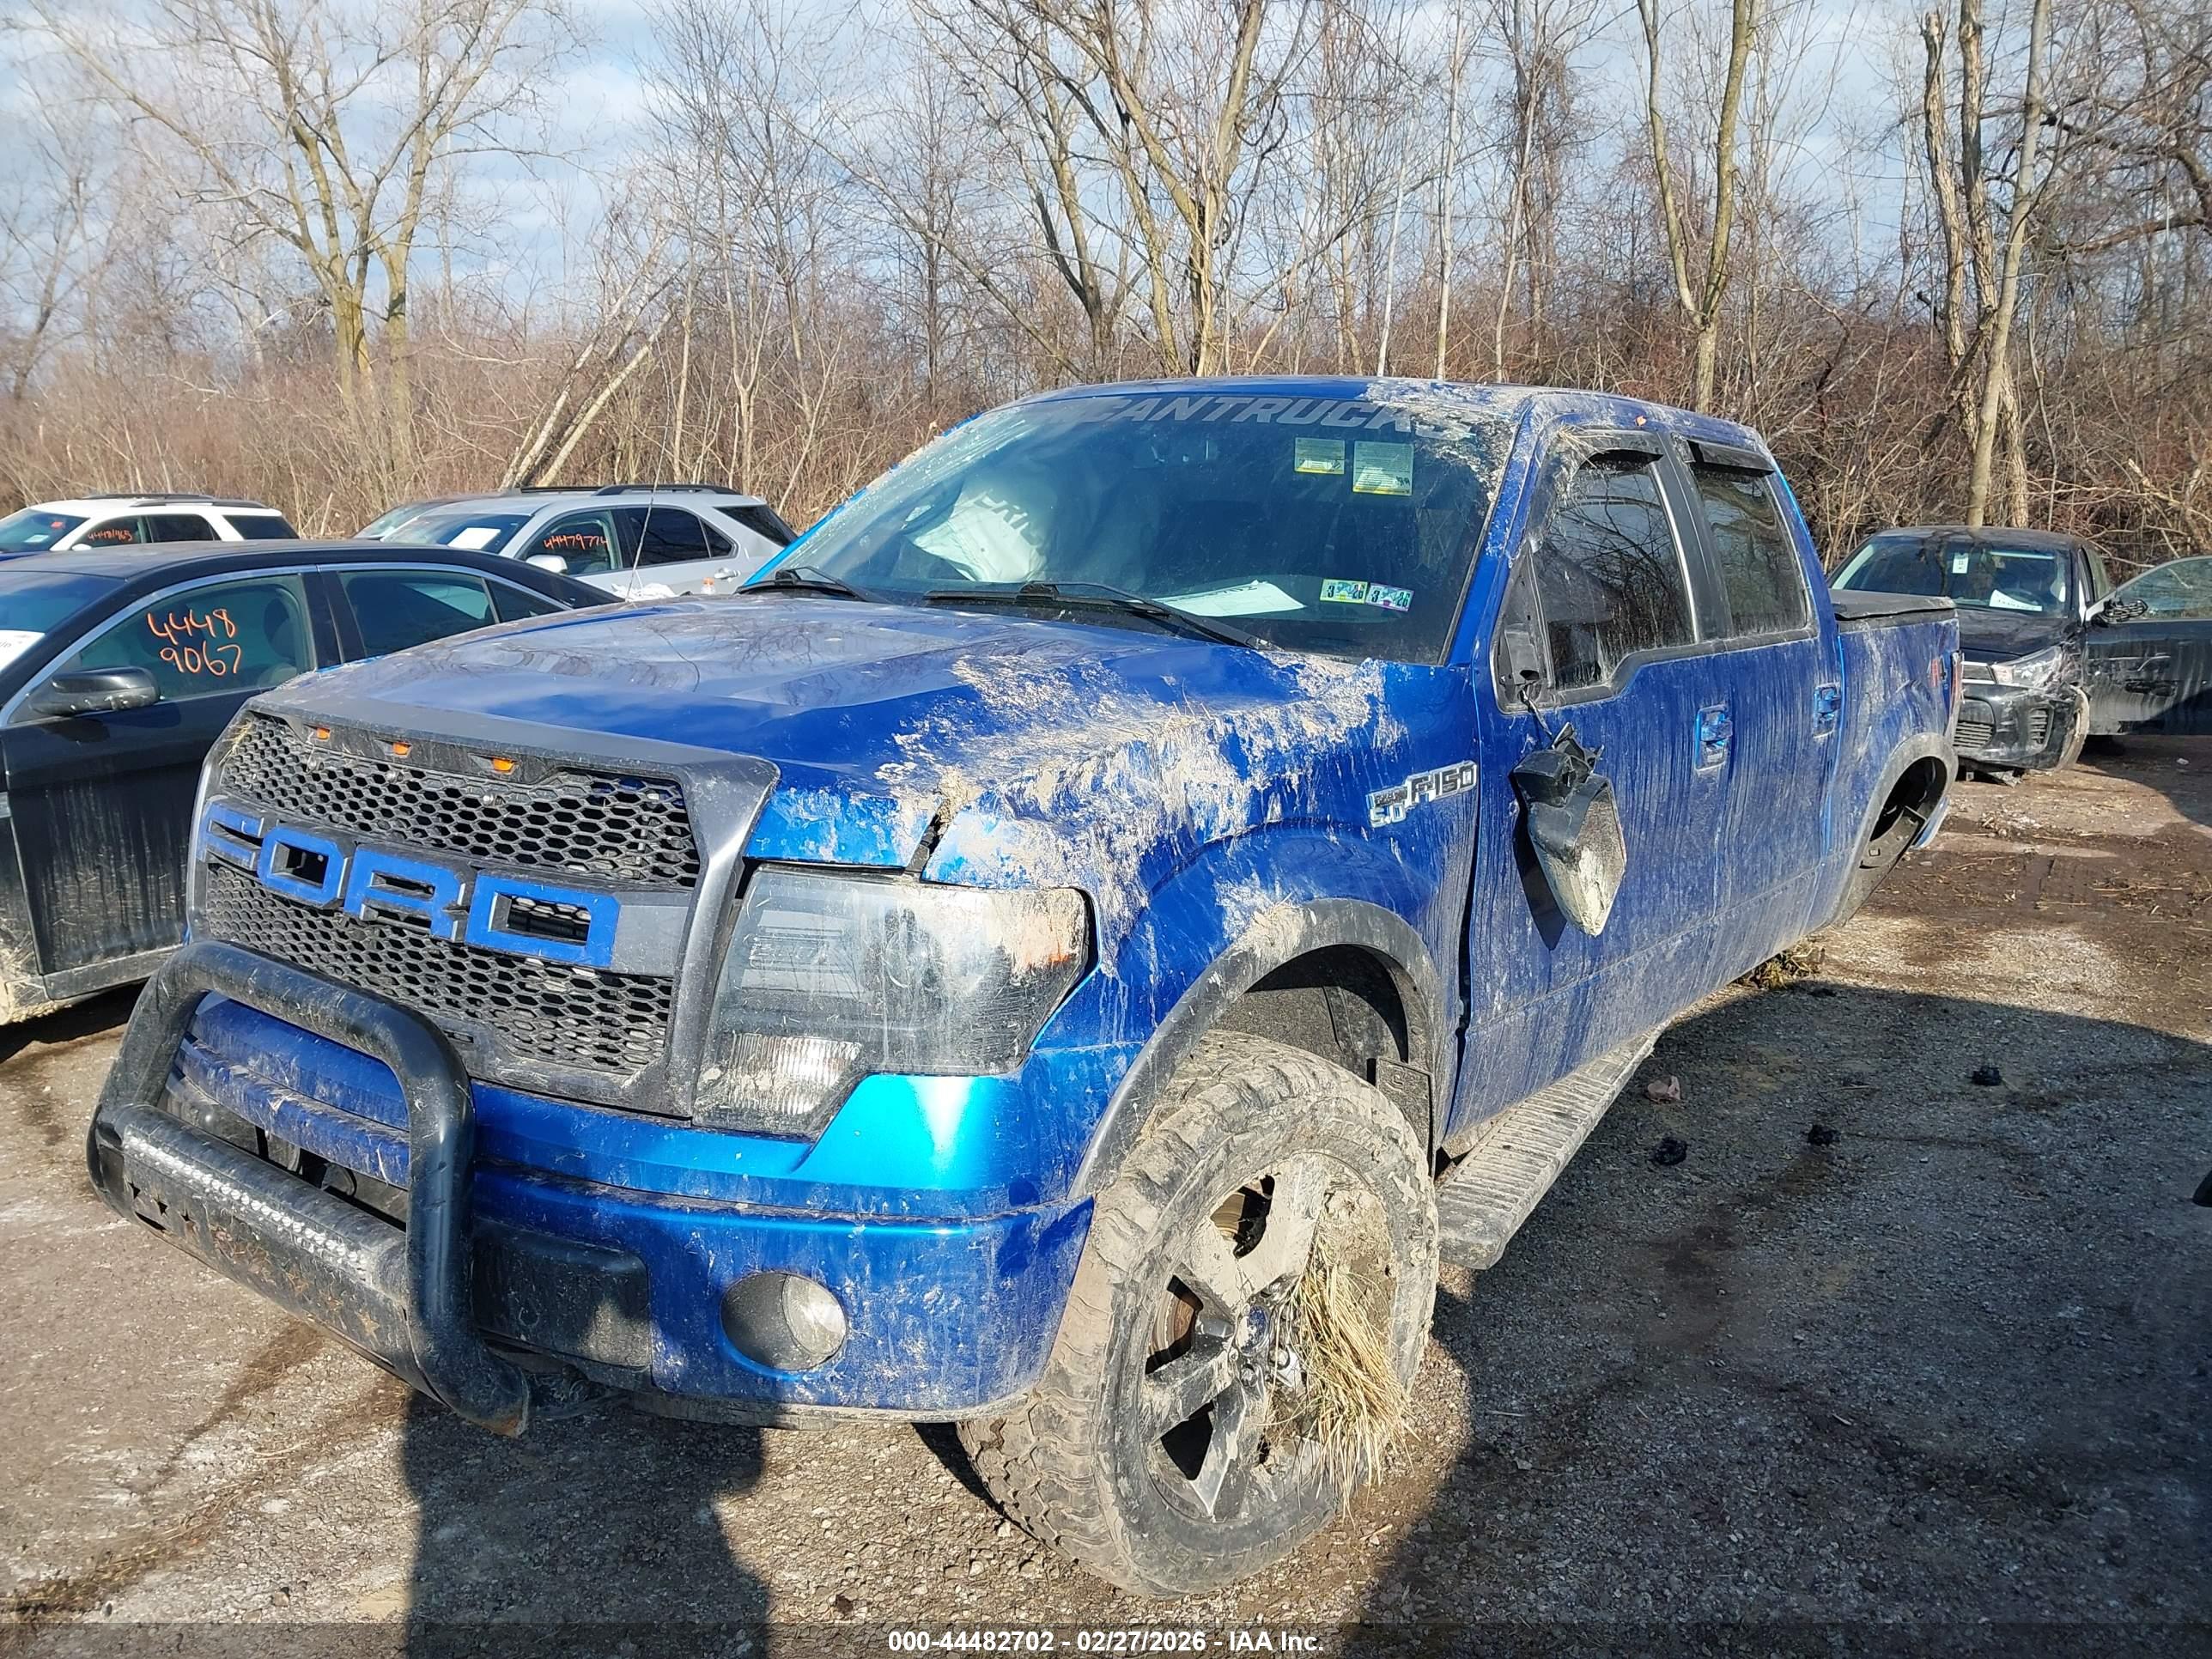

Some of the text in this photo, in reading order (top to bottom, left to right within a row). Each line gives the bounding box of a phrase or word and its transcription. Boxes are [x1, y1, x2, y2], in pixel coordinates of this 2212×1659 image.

[543, 533, 610, 550] 44479774
[1327, 585, 1334, 599] 3
[1371, 589, 1410, 607] 3 26
[147, 608, 236, 646] 4448
[160, 640, 241, 676] 9067
[197, 799, 621, 969] FORD
